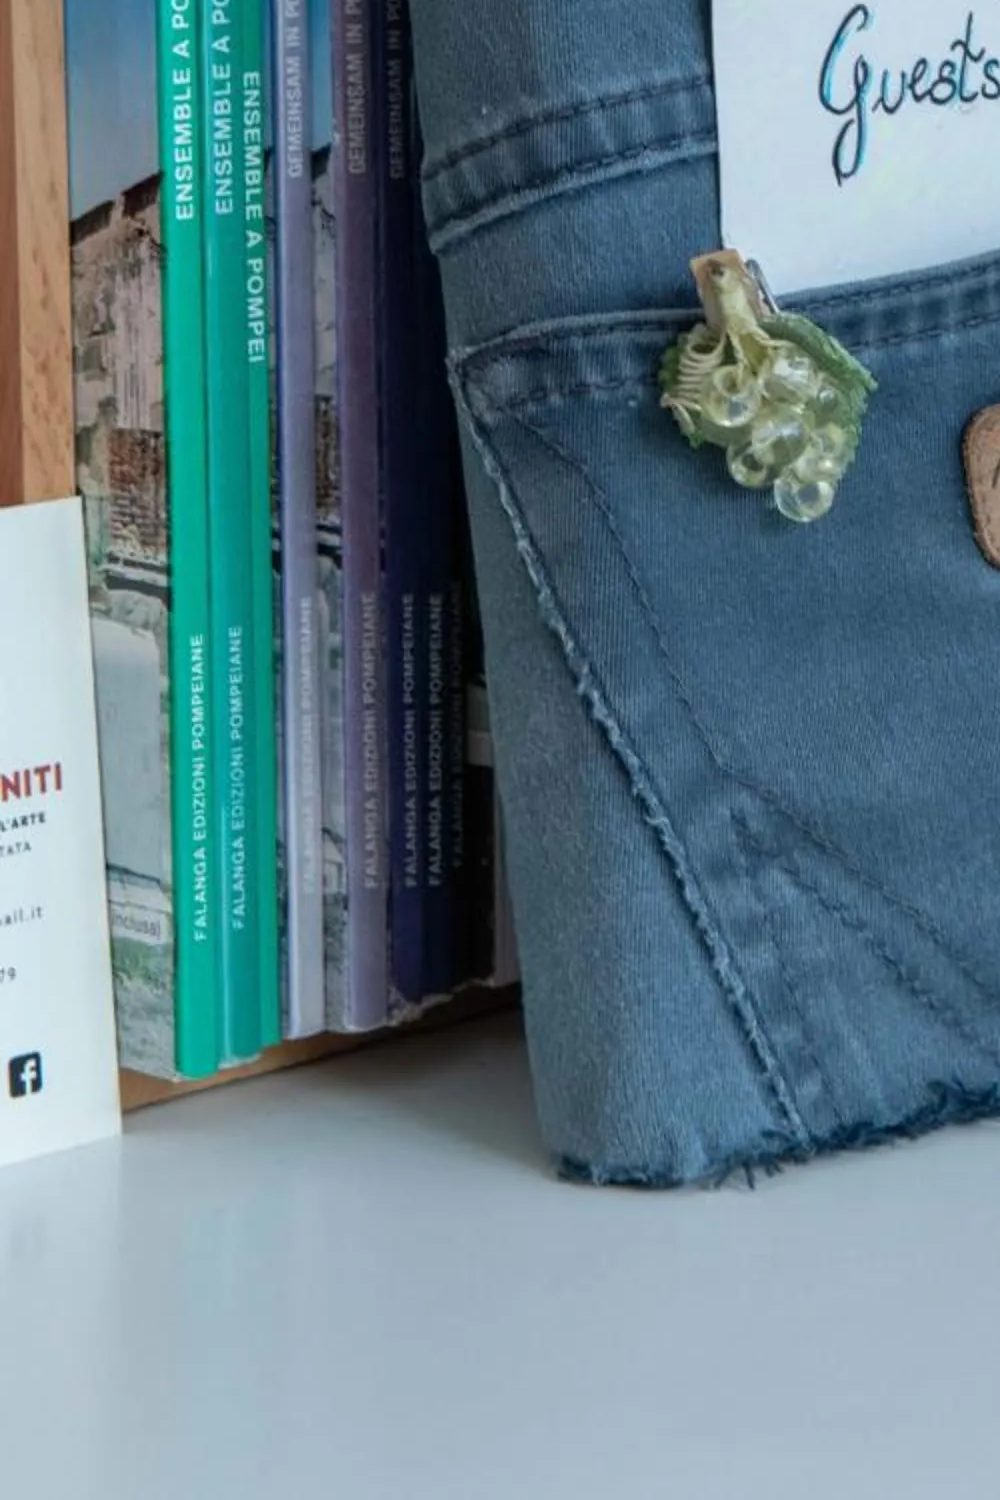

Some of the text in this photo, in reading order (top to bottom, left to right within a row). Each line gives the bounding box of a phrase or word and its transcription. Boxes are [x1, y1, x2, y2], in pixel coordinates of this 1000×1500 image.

[172, 38, 191, 57] A
[212, 34, 231, 54] A
[285, 26, 301, 48] IN
[345, 22, 364, 45] IN
[174, 66, 194, 221] ENSEMBLE
[212, 63, 233, 215] ENSEMBLE
[285, 56, 304, 179] GEMEINSAM
[345, 52, 367, 175] GEMEINSAM
[243, 71, 266, 363] ENSEMBLE A POMPEI
[189, 633, 209, 942] FALANGA EDIZIONI POMPEIANE
[227, 625, 247, 932] FALANGA EDIZIONI POMPEIANE
[361, 592, 379, 889] FALANGA EDIZIONI POMPEIANE
[402, 593, 418, 888] FALANGA EDIZIONI POMPEIANE
[428, 592, 444, 887] FALANGA EDIZIONI POMPEIANE
